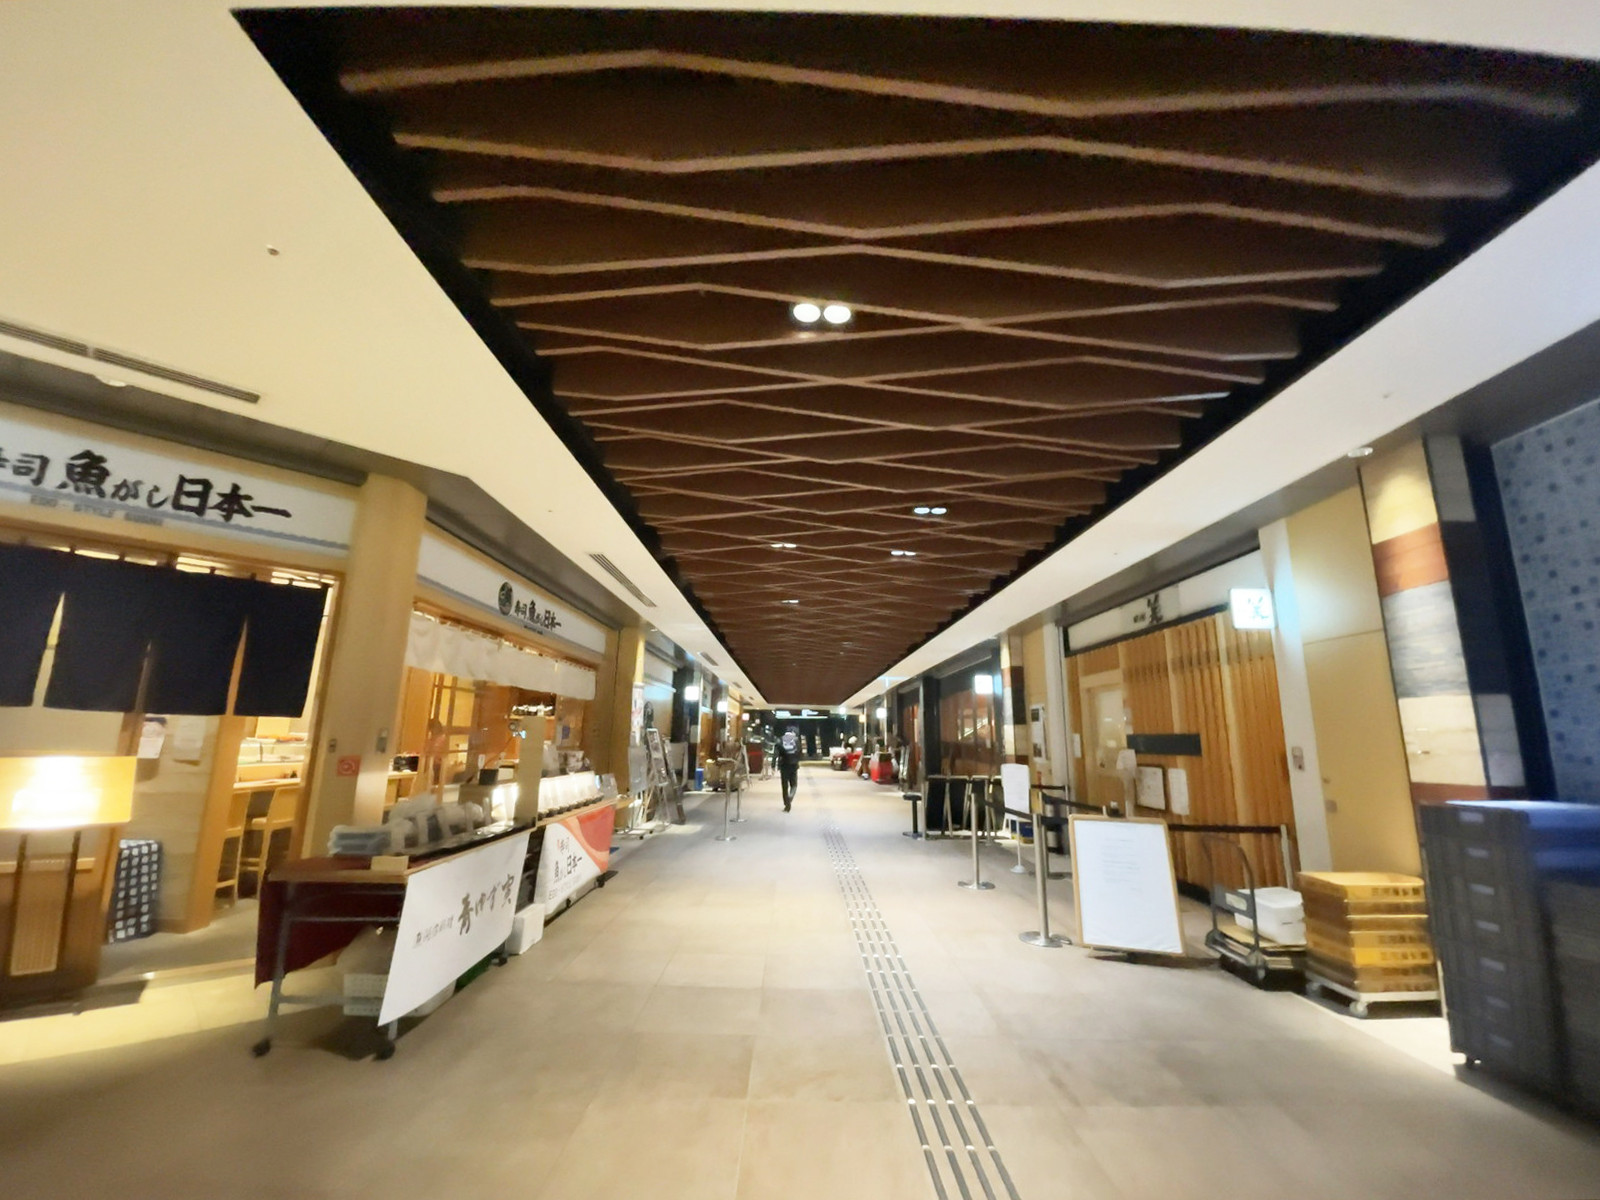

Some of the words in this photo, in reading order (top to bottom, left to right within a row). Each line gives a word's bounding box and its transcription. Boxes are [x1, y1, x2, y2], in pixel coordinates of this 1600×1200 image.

[55, 449, 292, 522] 魚がし日本一
